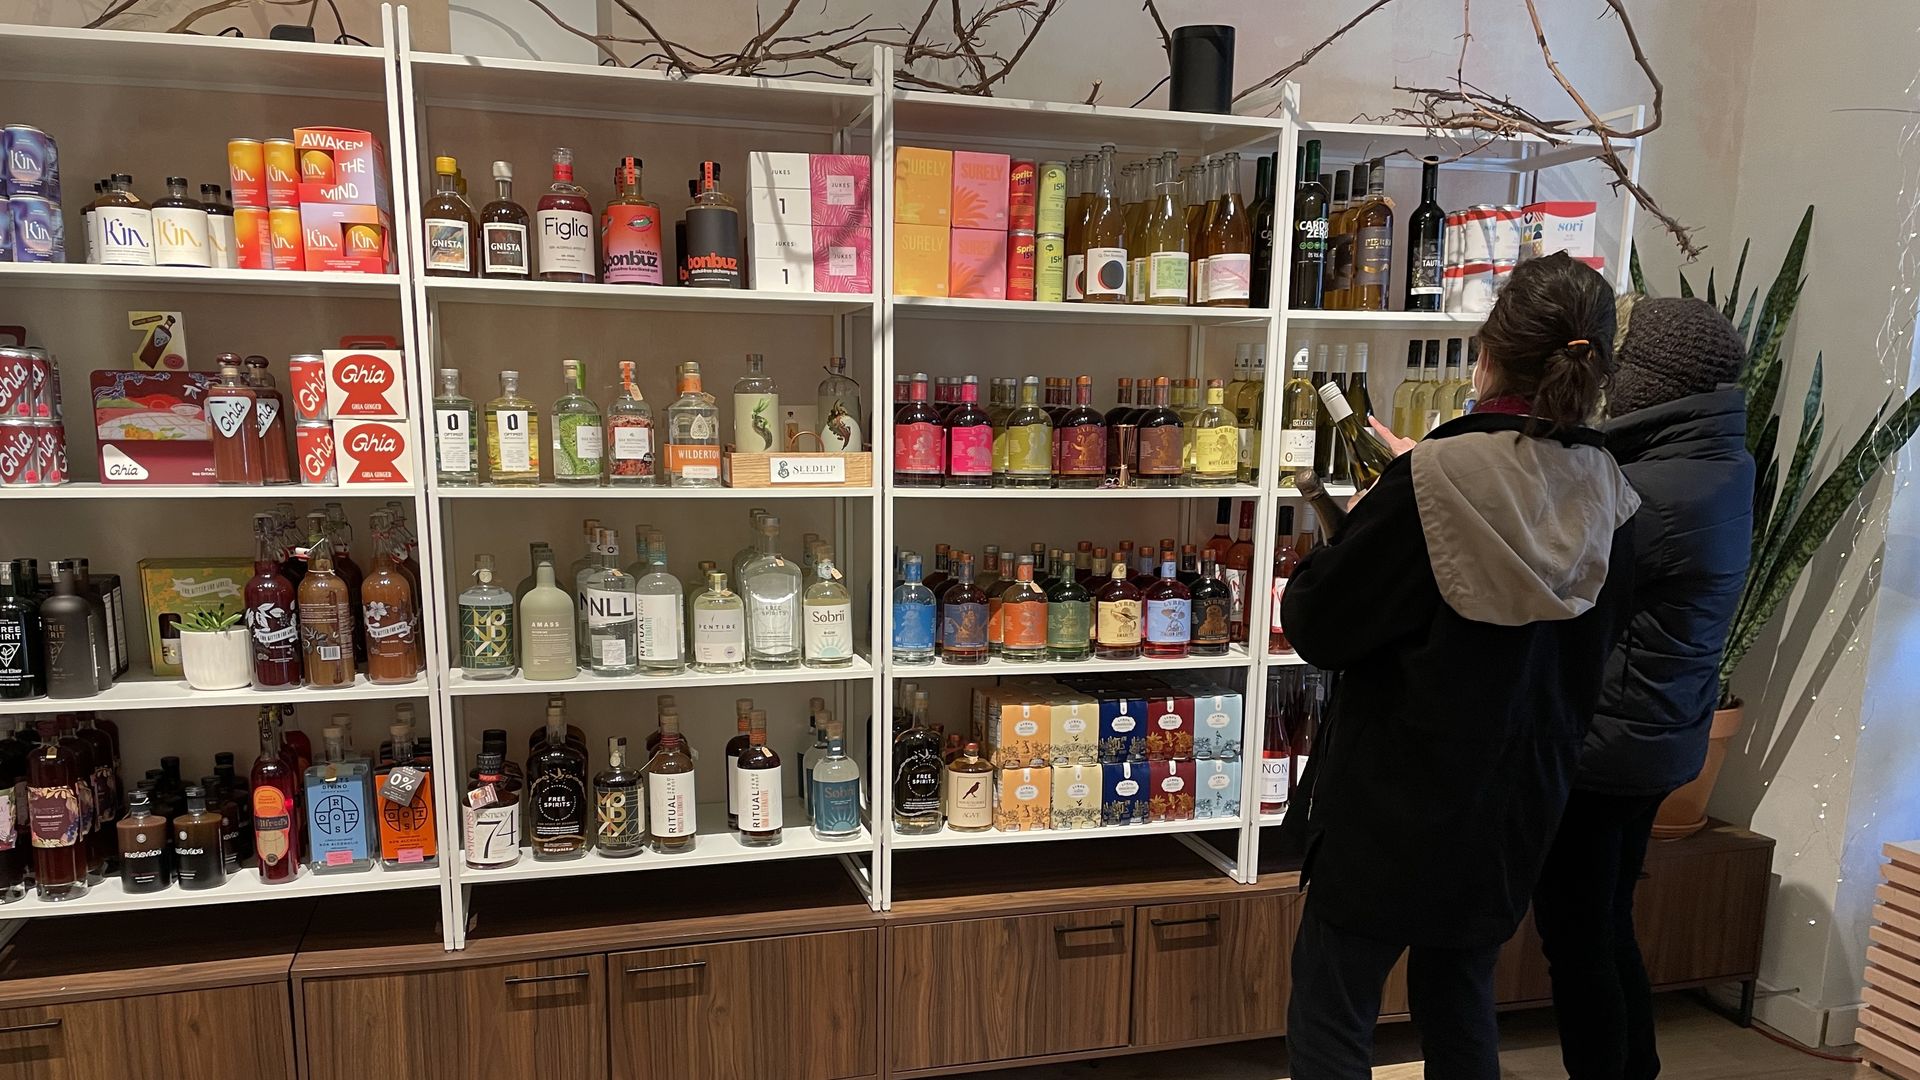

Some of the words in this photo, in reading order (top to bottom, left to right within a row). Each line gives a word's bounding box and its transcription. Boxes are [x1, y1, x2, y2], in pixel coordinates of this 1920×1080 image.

[301, 133, 363, 150] AWAKEN
[339, 158, 366, 173] THE
[905, 158, 947, 177] SURELY
[1011, 169, 1033, 181] Spritz
[1017, 178, 1031, 186] ISH
[320, 183, 359, 200] MIND
[779, 198, 786, 214] 1
[544, 217, 589, 240] Figlia
[1557, 220, 1584, 232] sori
[431, 239, 463, 249] GNISTA
[490, 242, 521, 252] GNISTA
[902, 234, 944, 252] SURELY
[688, 252, 738, 269] bonbuz
[1050, 255, 1063, 264] ISH
[782, 268, 789, 284] 1
[341, 364, 387, 384] Ghia
[220, 401, 245, 432] Ghia
[351, 433, 397, 453] Ghia
[0, 431, 33, 477] Ghia
[305, 433, 335, 477] Ghia
[109, 464, 139, 476] Ghia
[638, 617, 646, 657] RITUAL
[1262, 763, 1288, 774] NON
[390, 773, 415, 791] 0%
[1273, 783, 1278, 793] 1
[668, 795, 677, 834] RITUAL
[751, 790, 760, 828] RITUAL
[476, 809, 517, 858] 74
